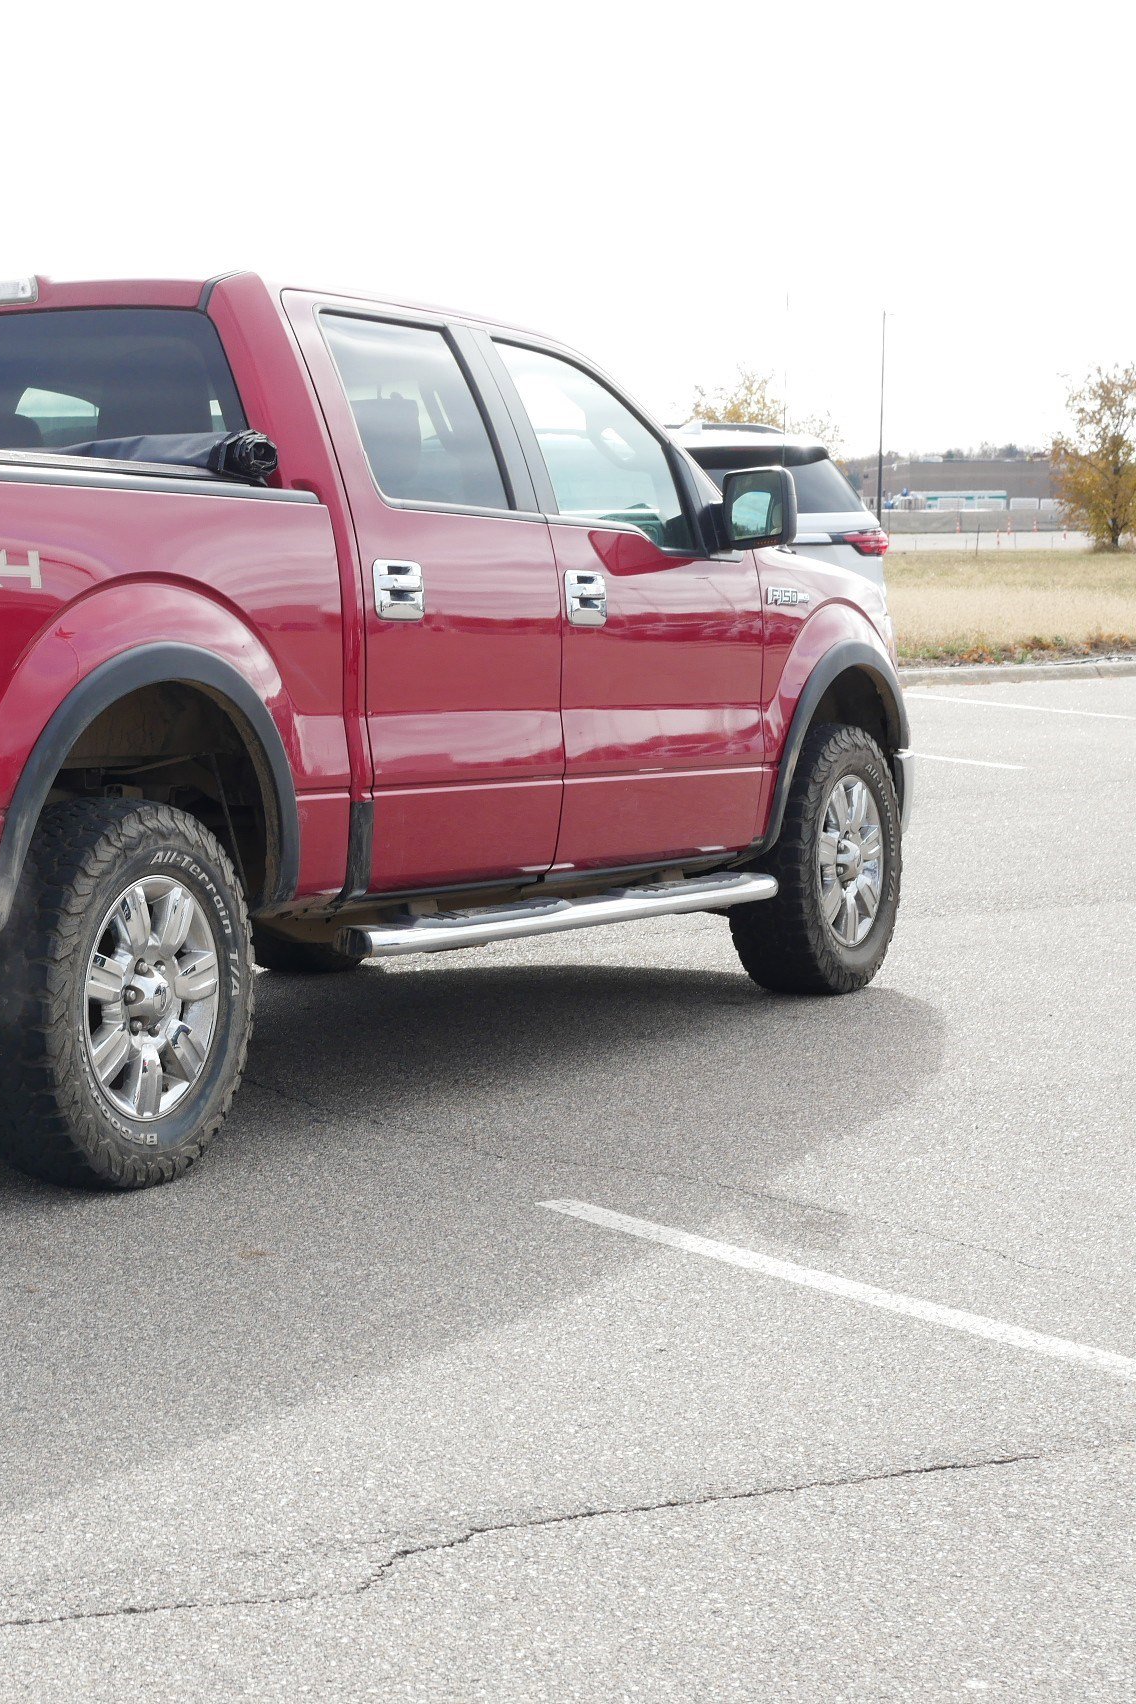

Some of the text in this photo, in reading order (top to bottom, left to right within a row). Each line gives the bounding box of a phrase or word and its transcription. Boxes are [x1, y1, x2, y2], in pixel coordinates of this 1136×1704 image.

[768, 586, 798, 605] F-150
[149, 850, 233, 935] All-Terrain
[229, 948, 240, 997] T/A
